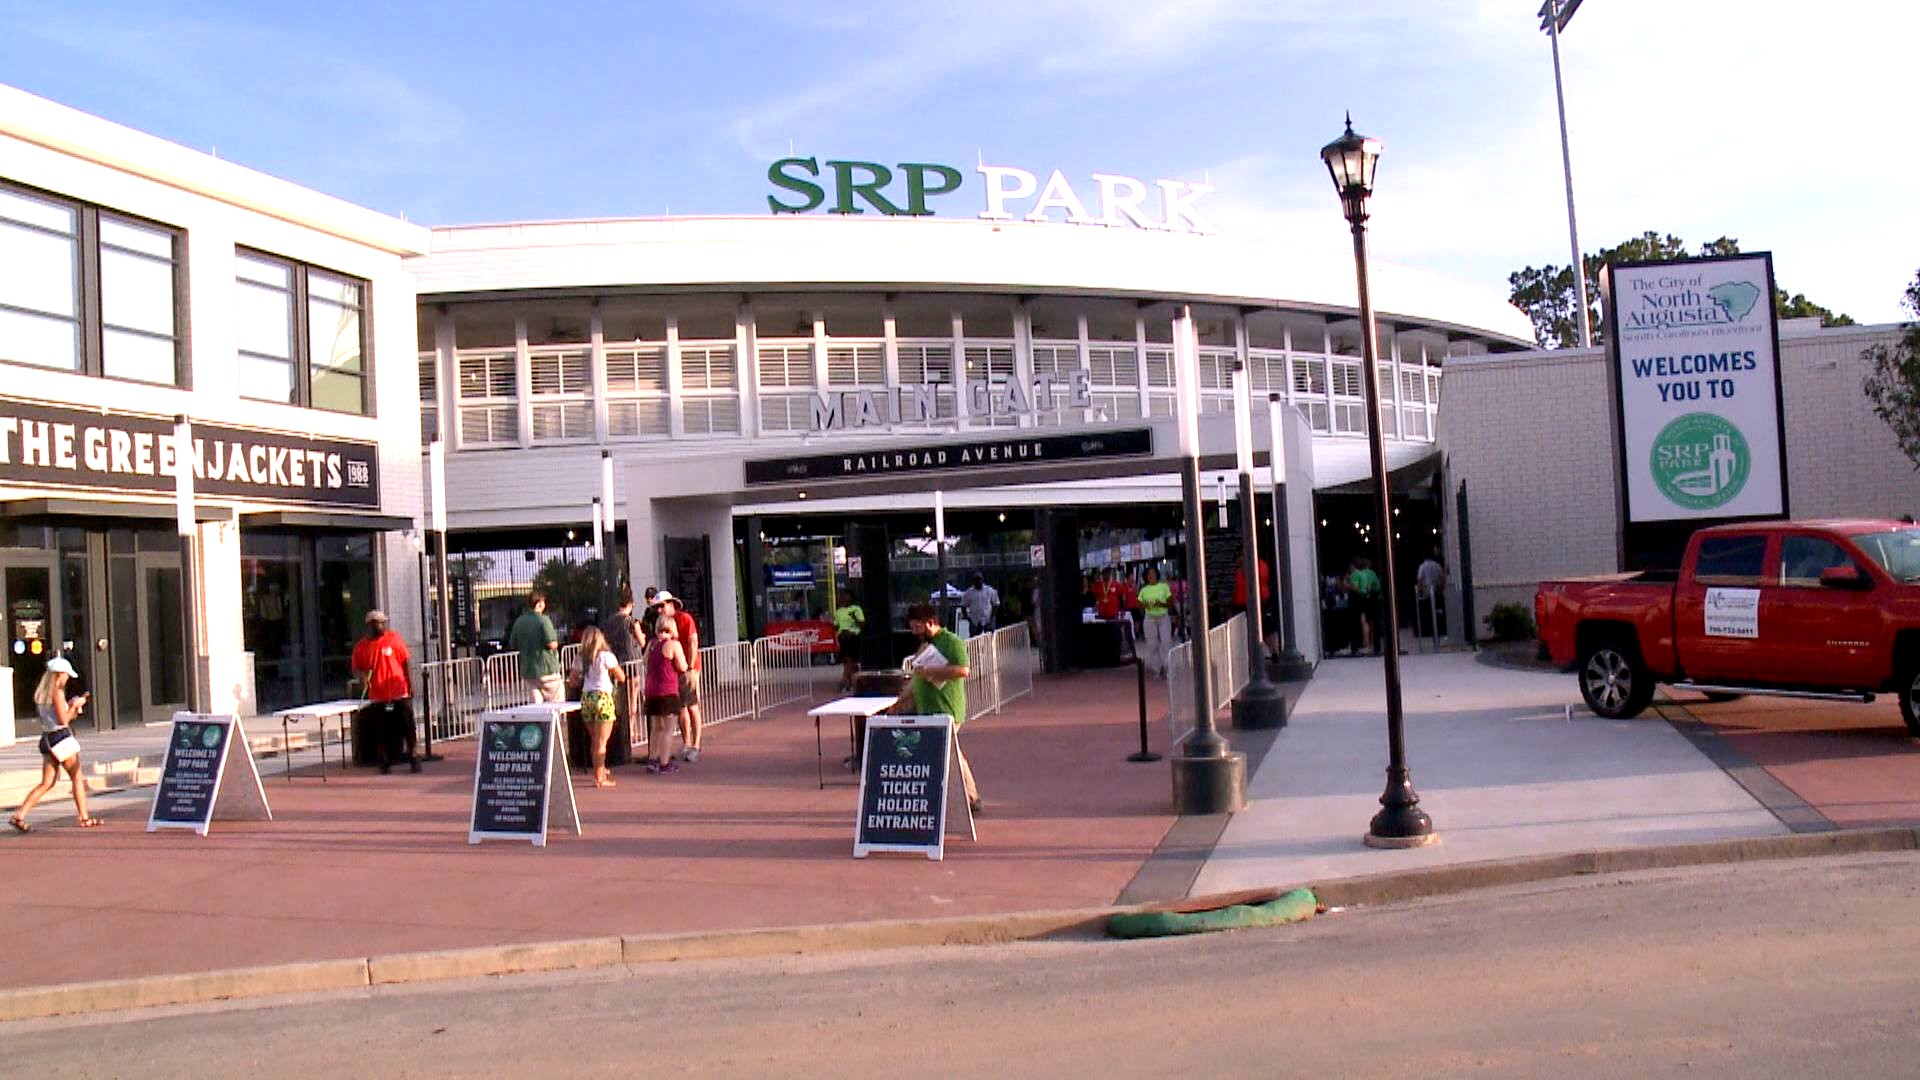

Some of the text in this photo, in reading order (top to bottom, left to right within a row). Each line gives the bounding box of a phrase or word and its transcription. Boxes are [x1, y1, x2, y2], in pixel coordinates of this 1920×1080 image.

[767, 156, 1221, 236] SRP PARK
[1630, 274, 1702, 291] The City of
[1642, 289, 1700, 310] North
[1625, 307, 1717, 328] Augusta
[1632, 351, 1756, 378] WELCOMES
[1657, 379, 1735, 402] YOU TO
[808, 369, 1092, 431] MAIN GATE
[0, 416, 77, 470] THE
[348, 463, 369, 483] 1988
[843, 443, 1043, 471] RAILROAD AVENUE
[1658, 443, 1709, 460] SRP
[175, 749, 217, 759] WELCOME TO
[489, 751, 541, 762] WELCOME TO
[191, 759, 209, 768] PARK
[494, 762, 532, 773] SRP PARK
[880, 765, 930, 778] SEASON
[881, 781, 927, 795] TICKET
[877, 799, 929, 812] HOLDER
[868, 815, 935, 830] ENTRANCE
